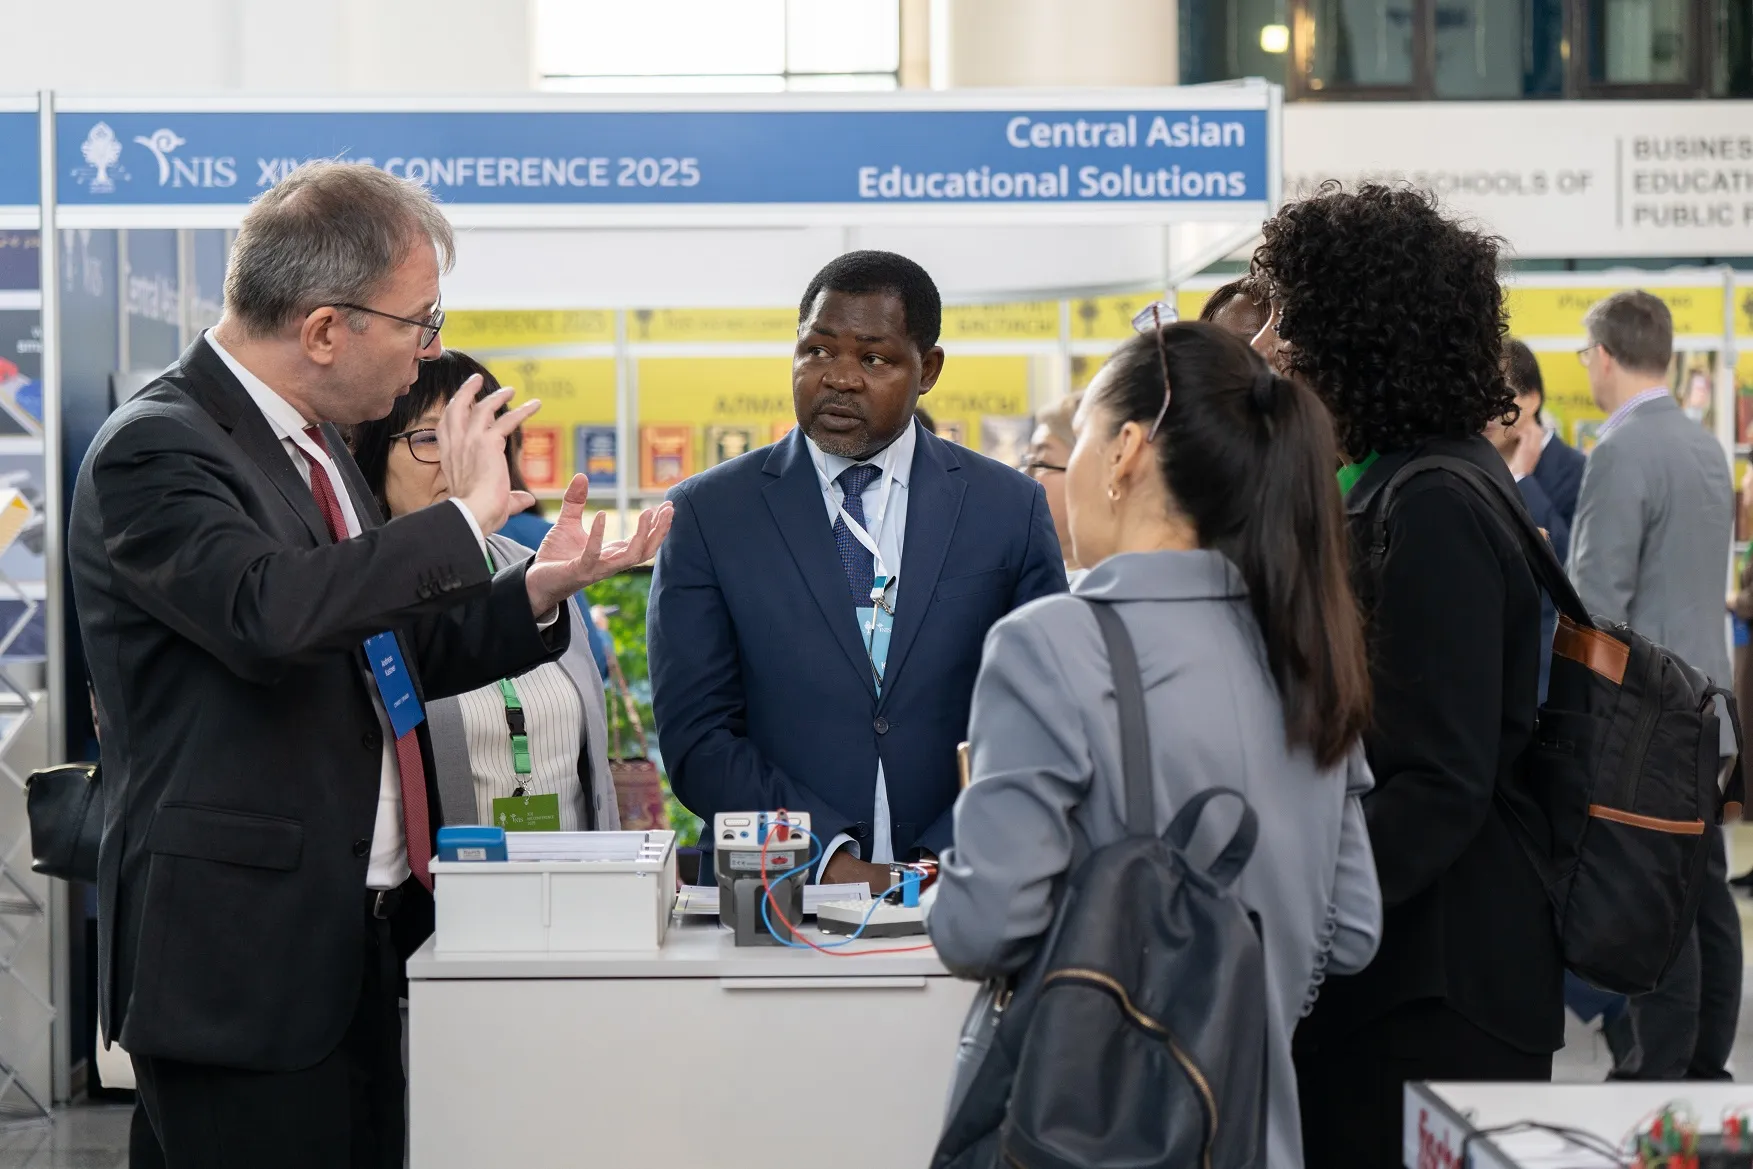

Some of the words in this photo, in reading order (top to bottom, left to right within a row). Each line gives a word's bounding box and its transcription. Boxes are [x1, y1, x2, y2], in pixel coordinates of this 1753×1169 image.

[1006, 116, 1137, 148] Central
[1145, 116, 1246, 148] Asian
[1633, 135, 1753, 160] BUSINES
[171, 157, 237, 188] NIS
[384, 157, 610, 187] CONFERENCE
[617, 157, 700, 187] 2025
[858, 165, 1068, 198] Educational
[1079, 165, 1246, 198] Solutions
[1555, 169, 1594, 197] OF
[1632, 202, 1735, 228] PUBLIC
